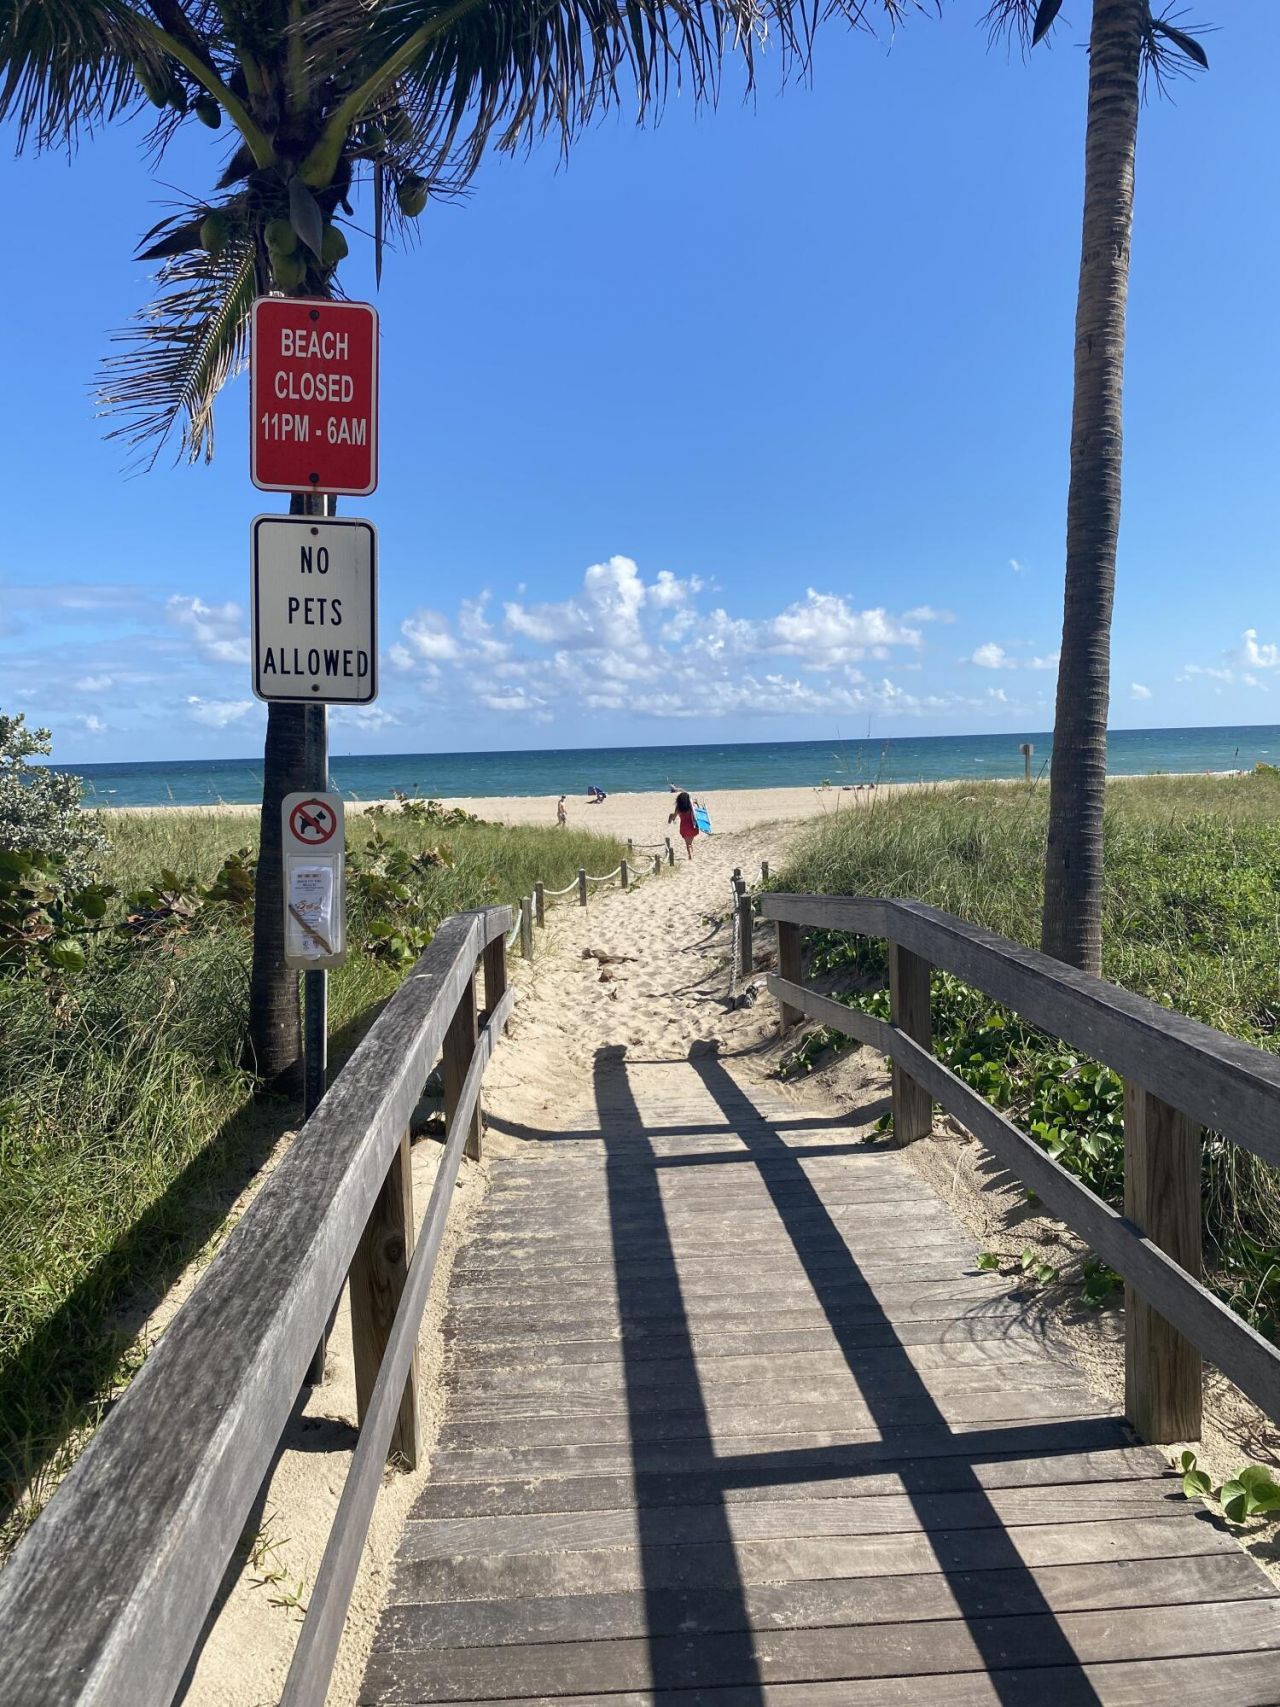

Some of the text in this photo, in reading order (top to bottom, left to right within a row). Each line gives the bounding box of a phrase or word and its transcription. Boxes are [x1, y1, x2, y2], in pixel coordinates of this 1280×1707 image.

[281, 328, 349, 360] BEACH
[274, 370, 354, 403] CLOSED
[261, 412, 309, 442] 11PM
[327, 416, 367, 446] 6AM
[300, 546, 329, 574] NO
[288, 596, 342, 626] PETS
[263, 647, 368, 678] ALLOWED
